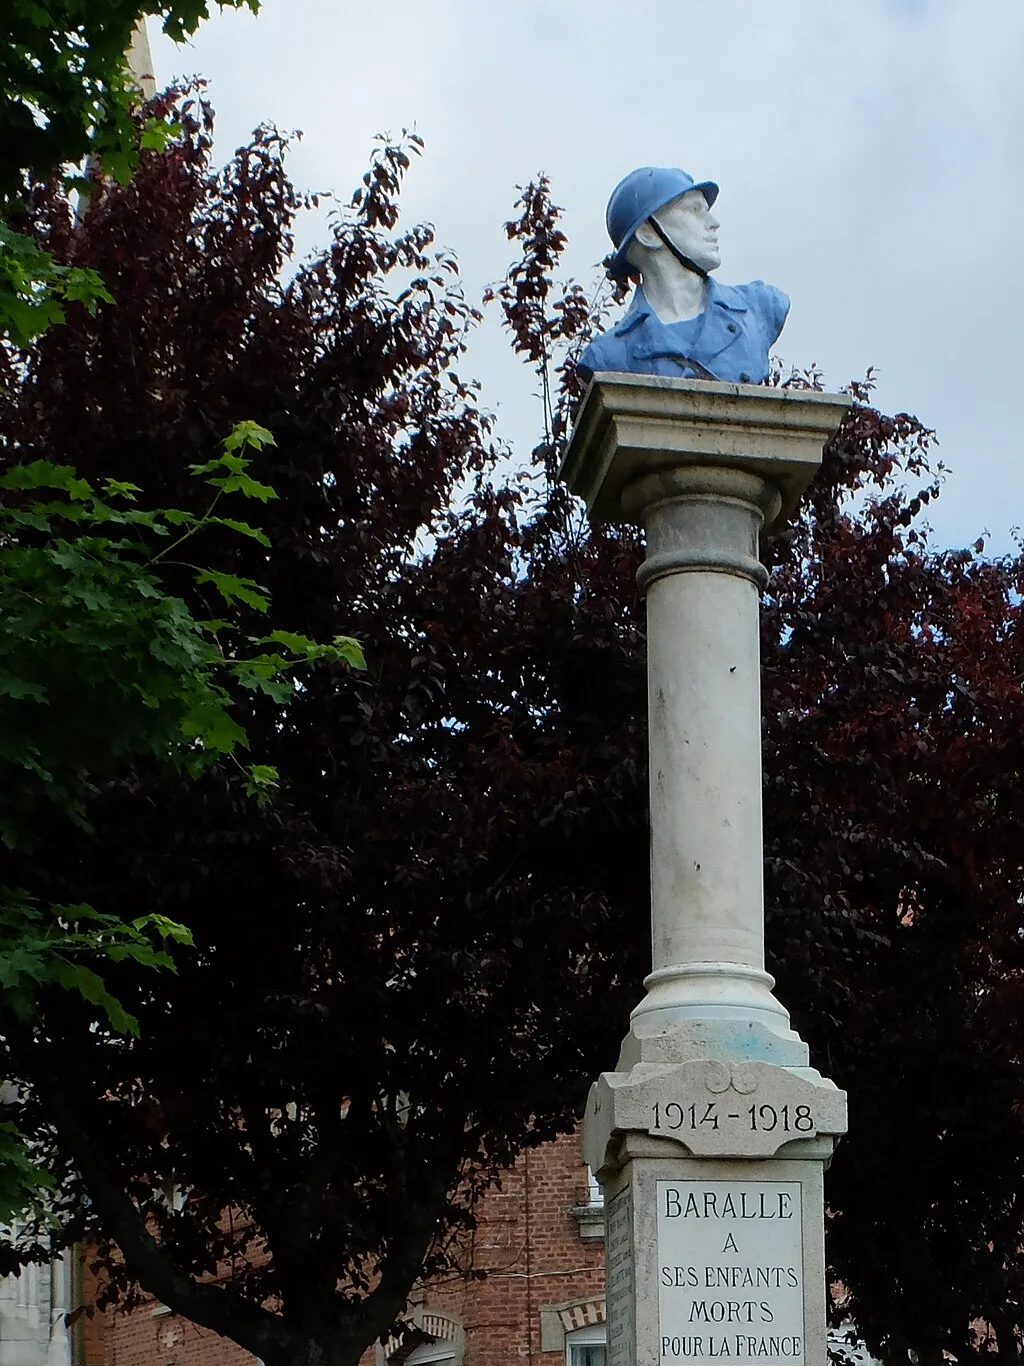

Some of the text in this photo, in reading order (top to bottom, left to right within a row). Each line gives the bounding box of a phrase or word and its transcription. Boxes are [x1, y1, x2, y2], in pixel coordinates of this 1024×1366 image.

[665, 1188, 793, 1219] BARALLE
[721, 1232, 739, 1253] A
[661, 1266, 799, 1288] SES ENFANTS
[688, 1301, 774, 1323] MORTS
[661, 1334, 801, 1357] POUR LA FRANCE
